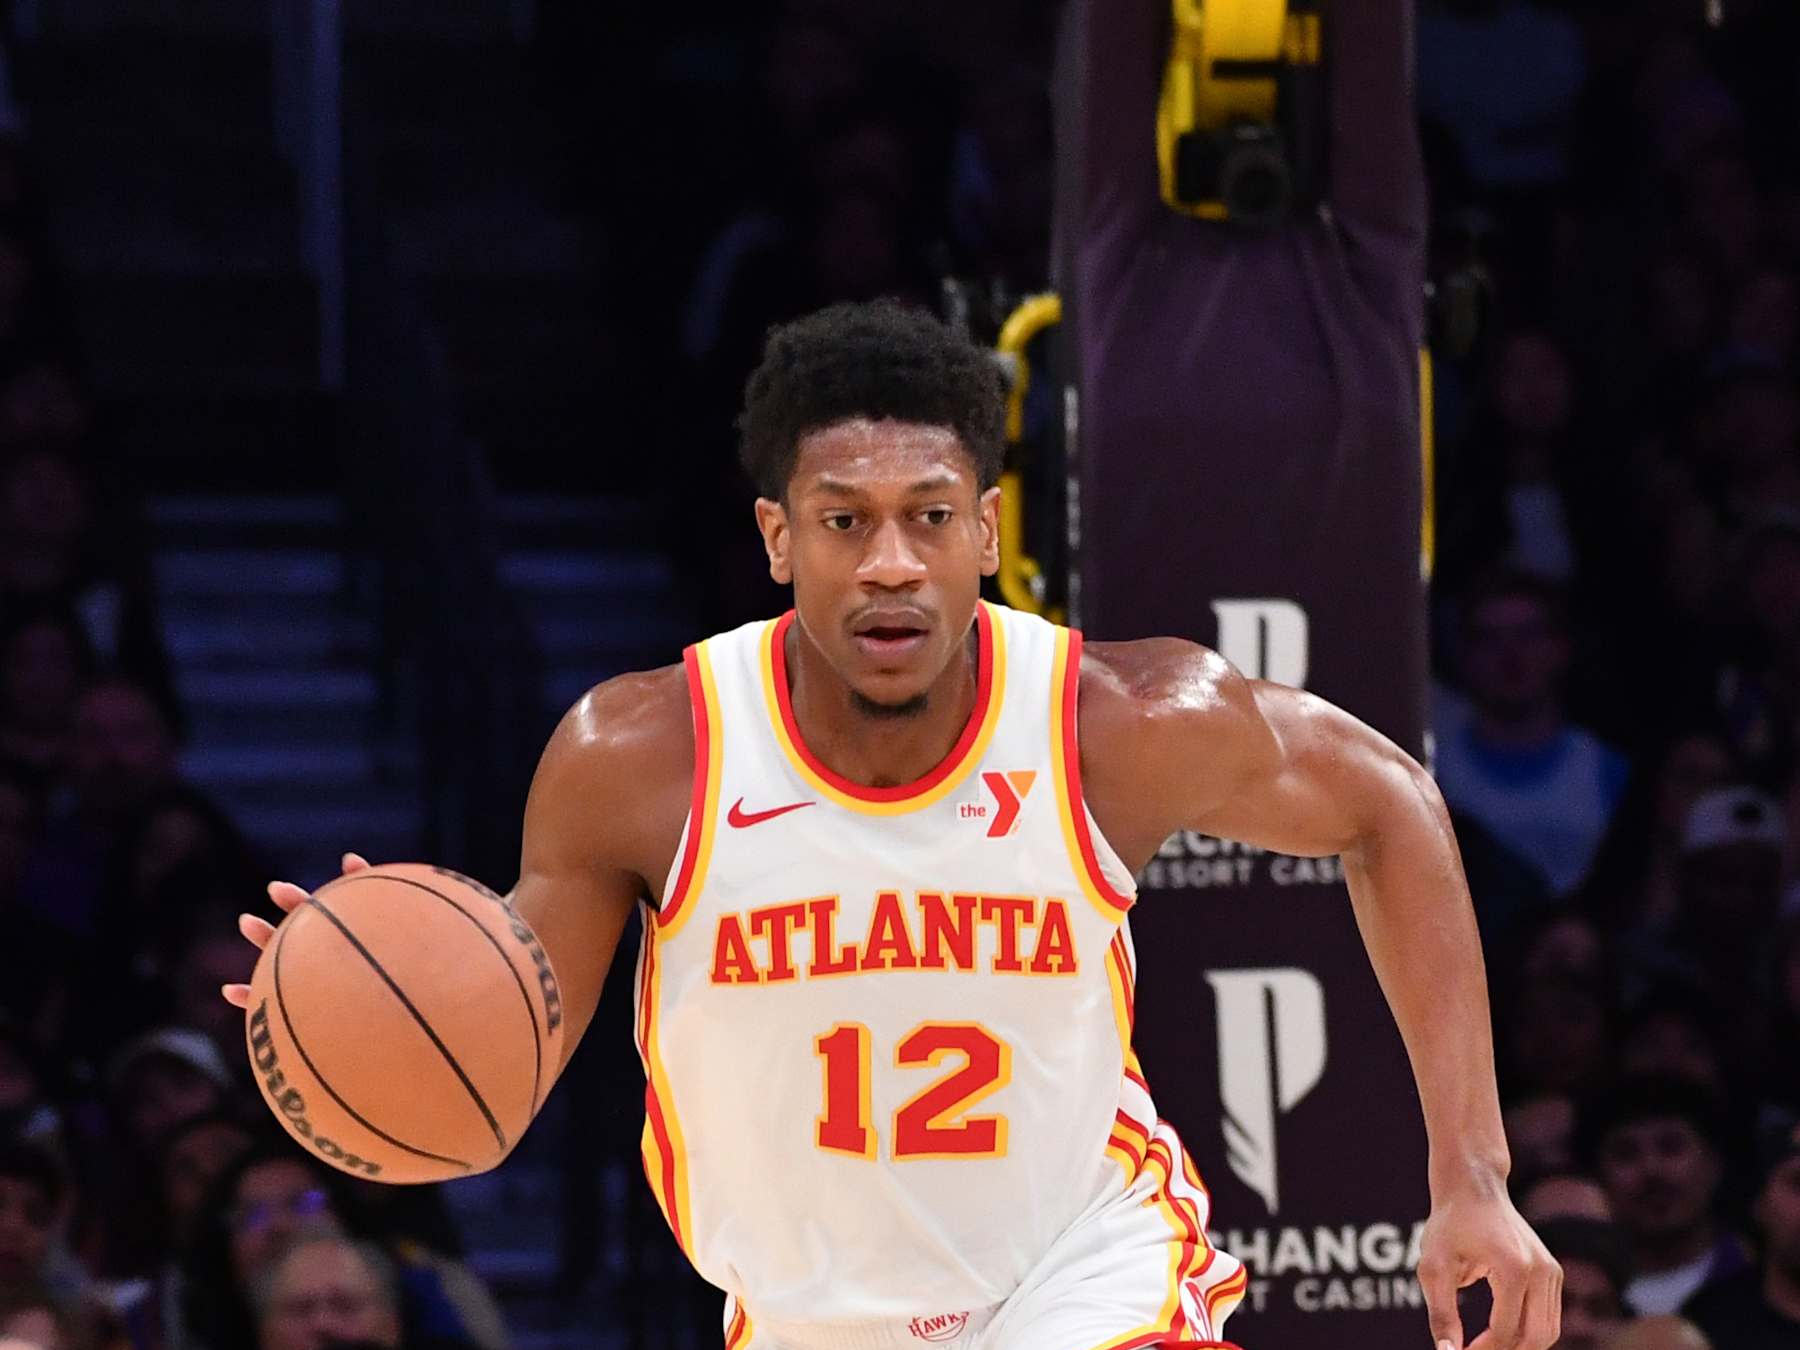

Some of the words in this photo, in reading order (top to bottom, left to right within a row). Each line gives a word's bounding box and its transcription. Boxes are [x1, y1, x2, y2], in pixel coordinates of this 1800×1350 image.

[960, 803, 986, 818] the
[1136, 857, 1253, 889] ESORT
[708, 889, 1080, 987] ATLANTA
[250, 997, 383, 1176] Wilson
[813, 1020, 1013, 1162] 12
[1208, 1221, 1427, 1275] HANG
